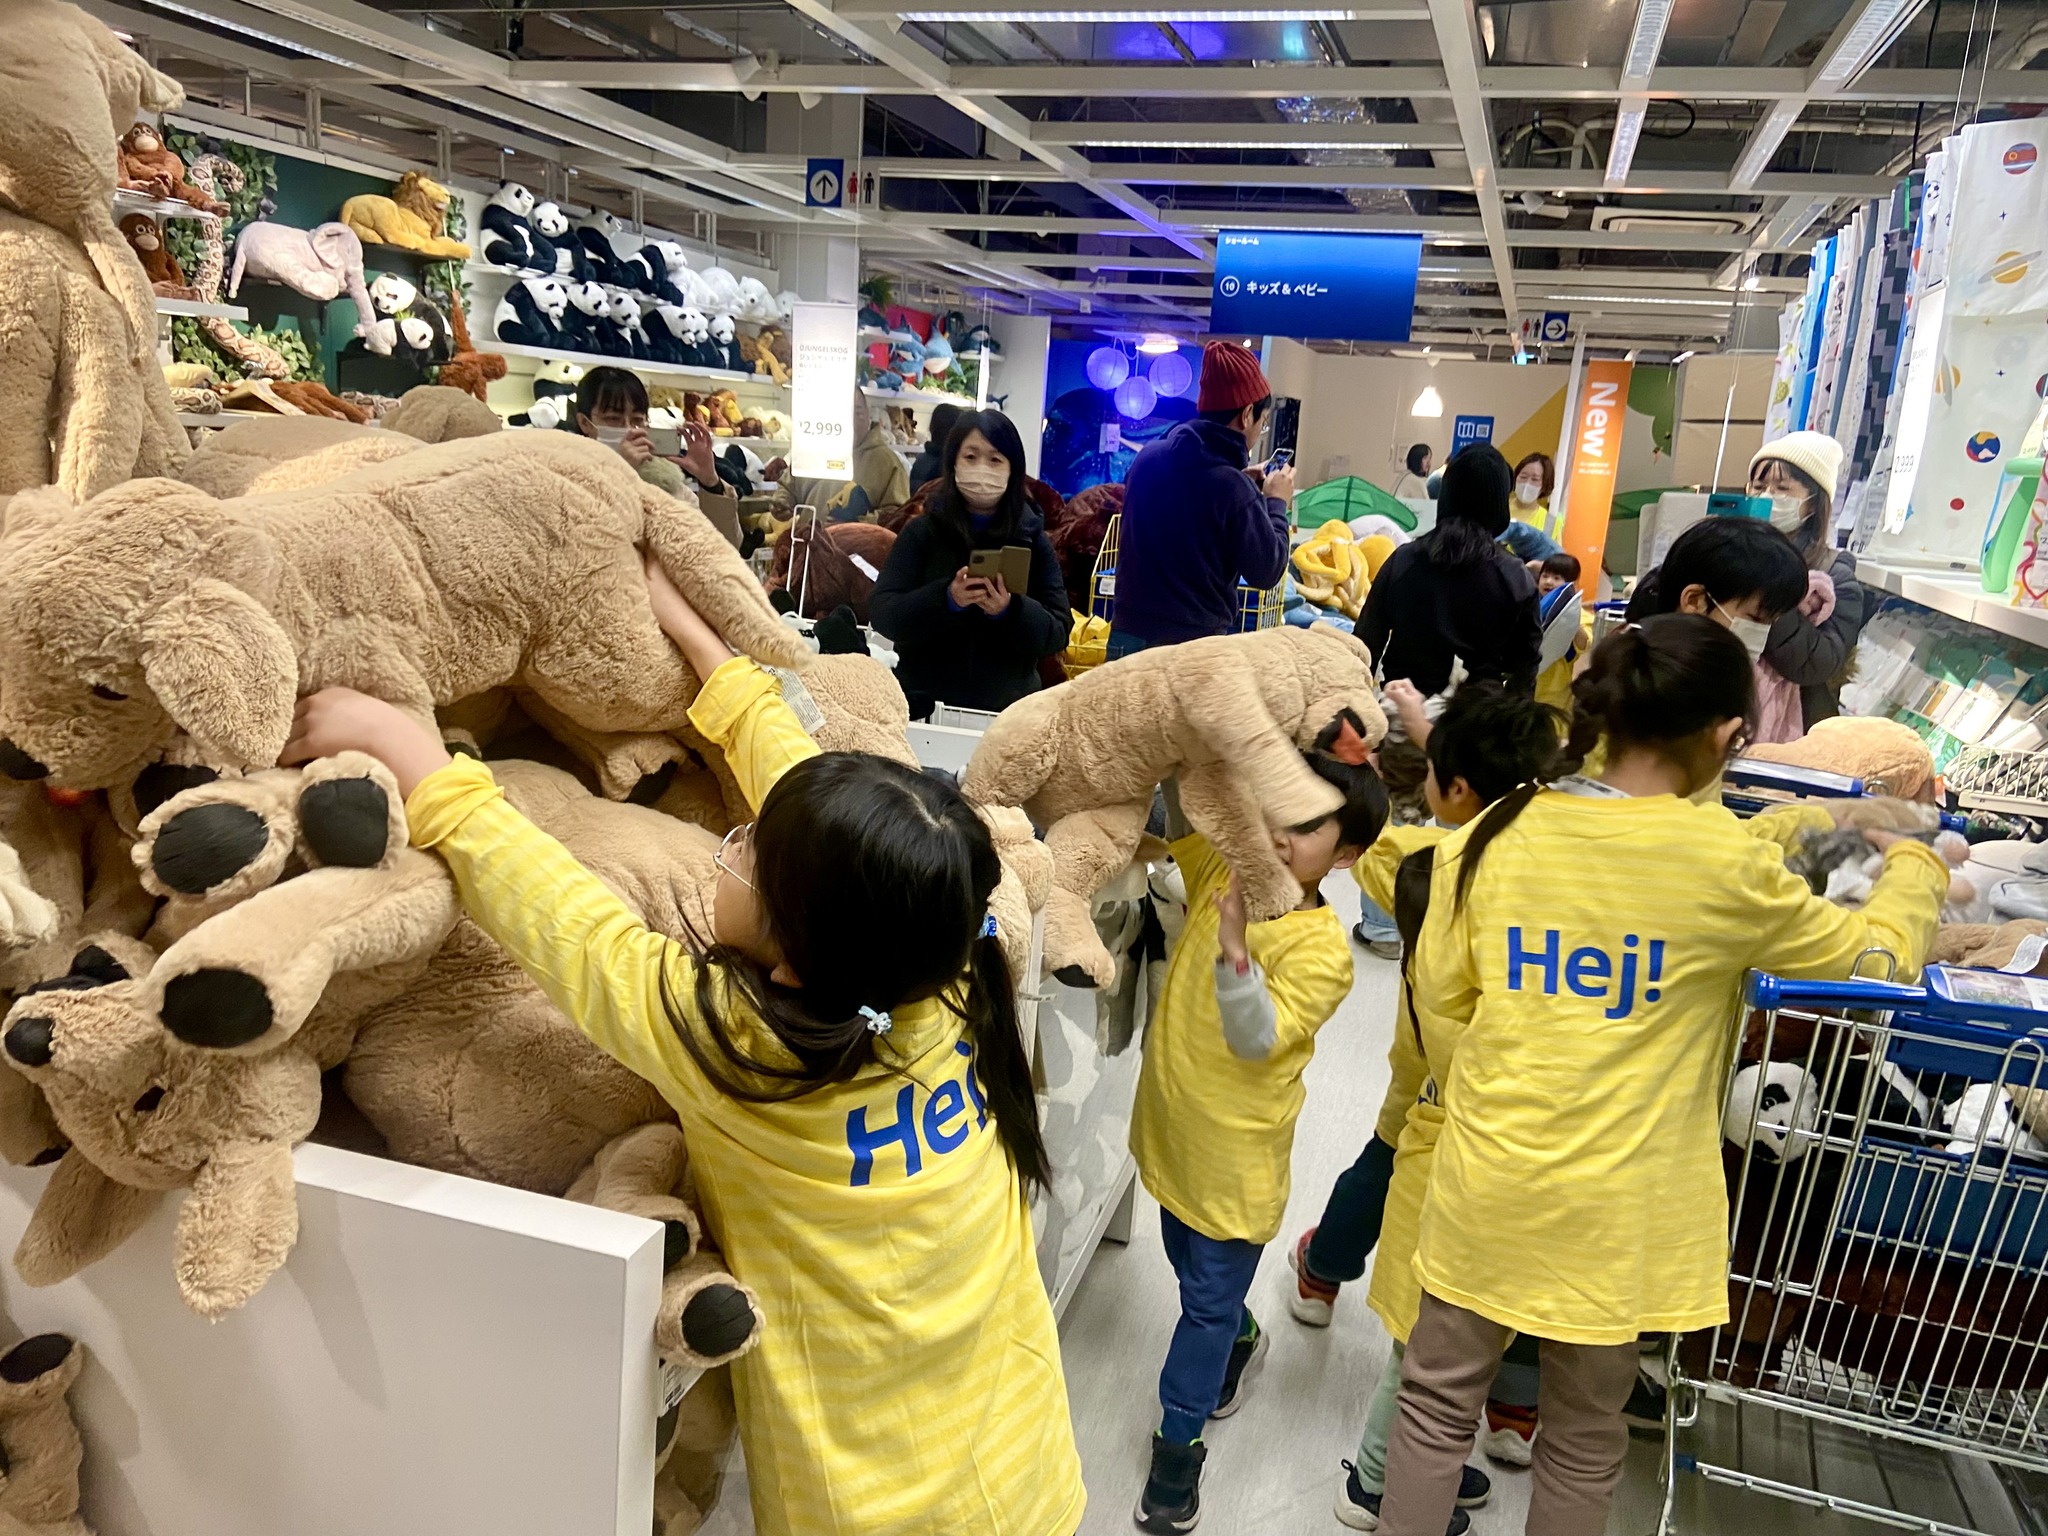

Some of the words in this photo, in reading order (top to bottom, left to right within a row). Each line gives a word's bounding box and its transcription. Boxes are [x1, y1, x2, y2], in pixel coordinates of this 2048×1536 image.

[1225, 237, 1259, 245] ショールーム
[1225, 281, 1235, 291] 10
[799, 344, 848, 354] DJUNGELSKOG
[1581, 382, 1619, 458] New
[1507, 926, 1665, 1020] Hej!
